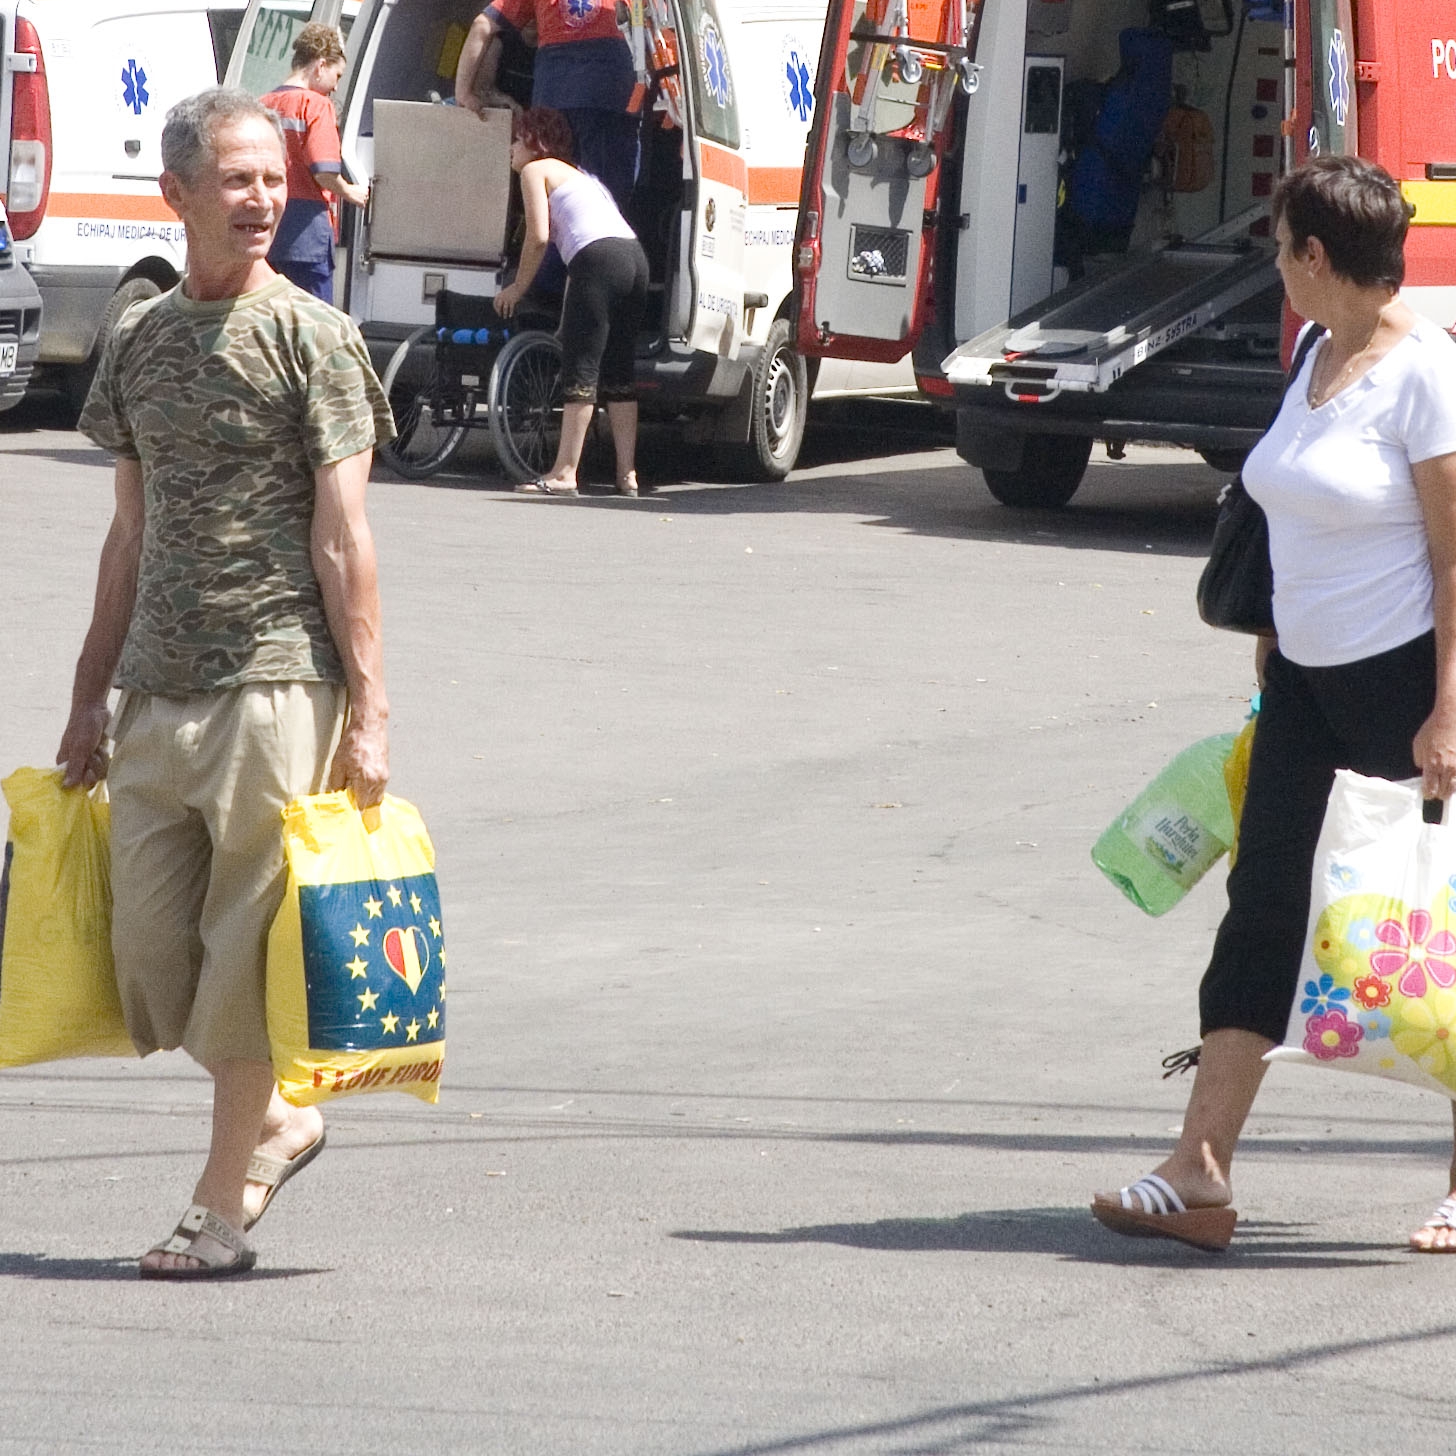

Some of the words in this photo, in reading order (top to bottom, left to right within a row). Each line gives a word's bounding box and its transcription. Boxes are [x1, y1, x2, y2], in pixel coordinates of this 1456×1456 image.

[77, 222, 116, 239] ECHIPAJ
[118, 224, 155, 240] MEDICAL
[159, 227, 172, 241] DE
[331, 1066, 393, 1093] LOVE
